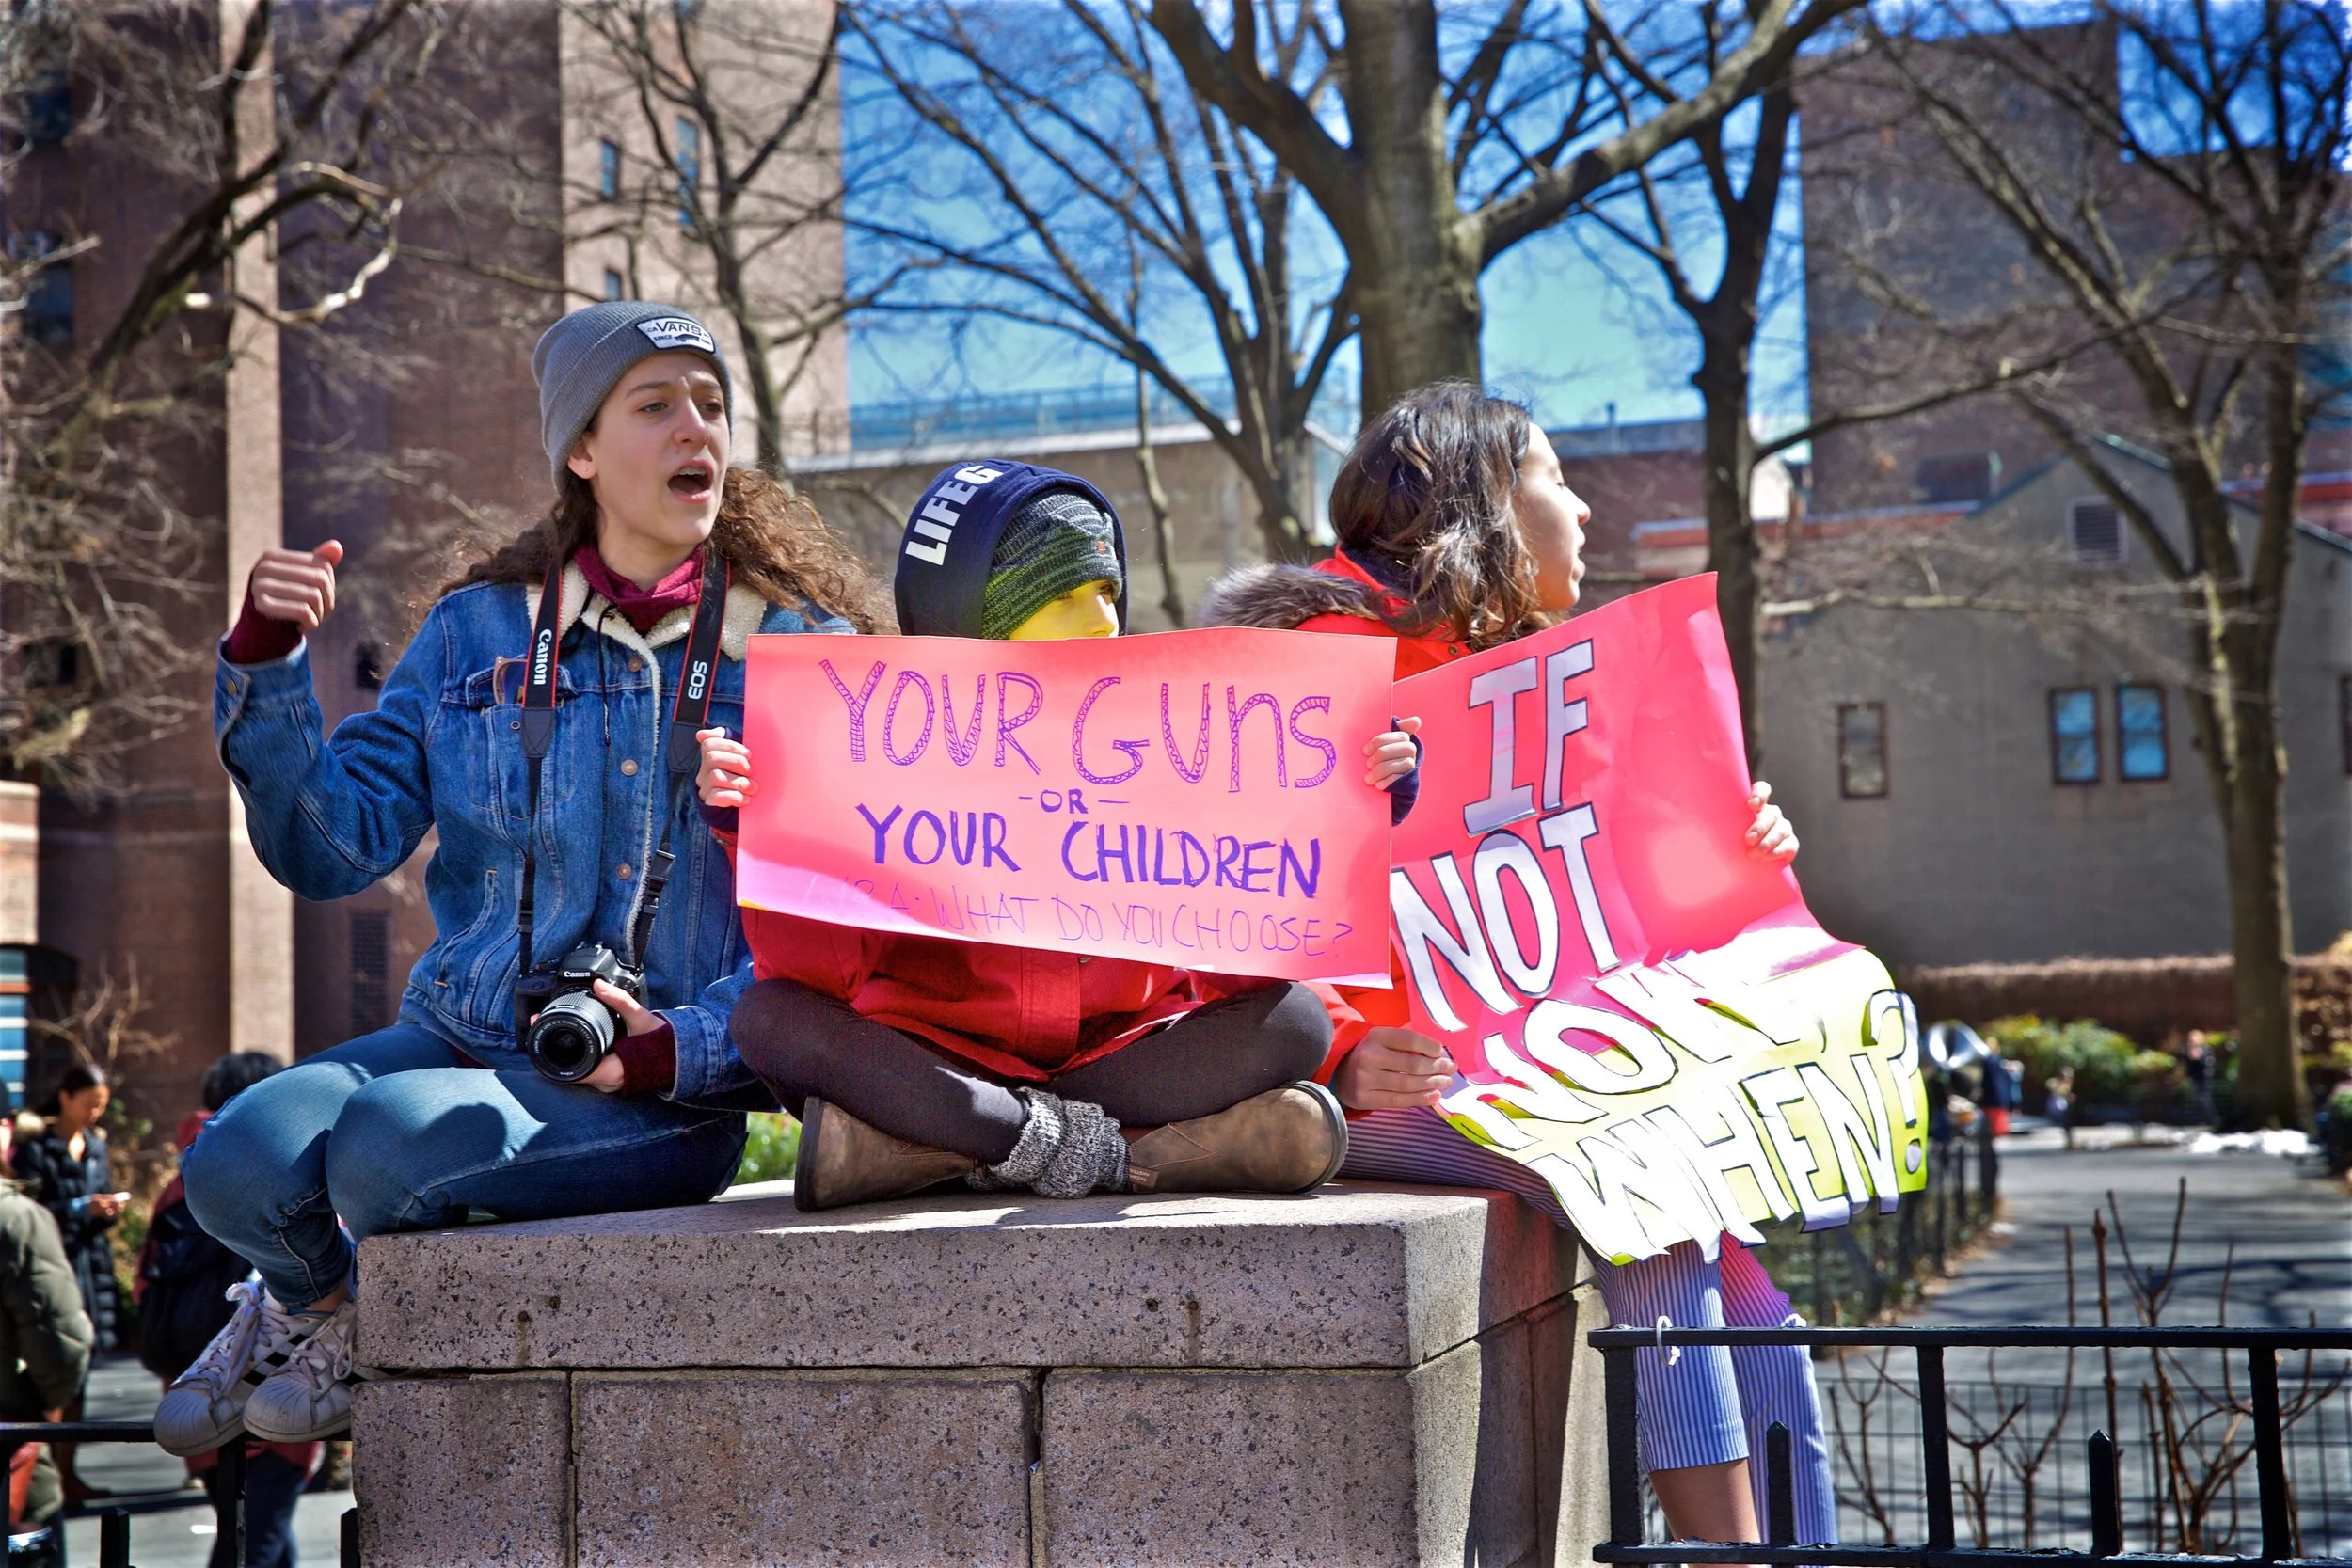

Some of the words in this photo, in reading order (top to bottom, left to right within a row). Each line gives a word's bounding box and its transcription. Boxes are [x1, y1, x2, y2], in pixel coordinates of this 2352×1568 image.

[655, 321, 702, 336] VANS
[533, 628, 552, 686] Canon
[688, 660, 708, 700] EOS
[818, 659, 1043, 775] YOUR
[1463, 638, 1595, 837] IF
[855, 803, 1022, 873] YOUR
[1060, 820, 1322, 899] CHILDREN
[930, 884, 1039, 934] WHAT
[1051, 893, 1104, 942] DO
[1172, 903, 1354, 958] CHOOSE?
[1391, 804, 1623, 1033] NOT
[1524, 990, 1922, 1264] WHEN?
